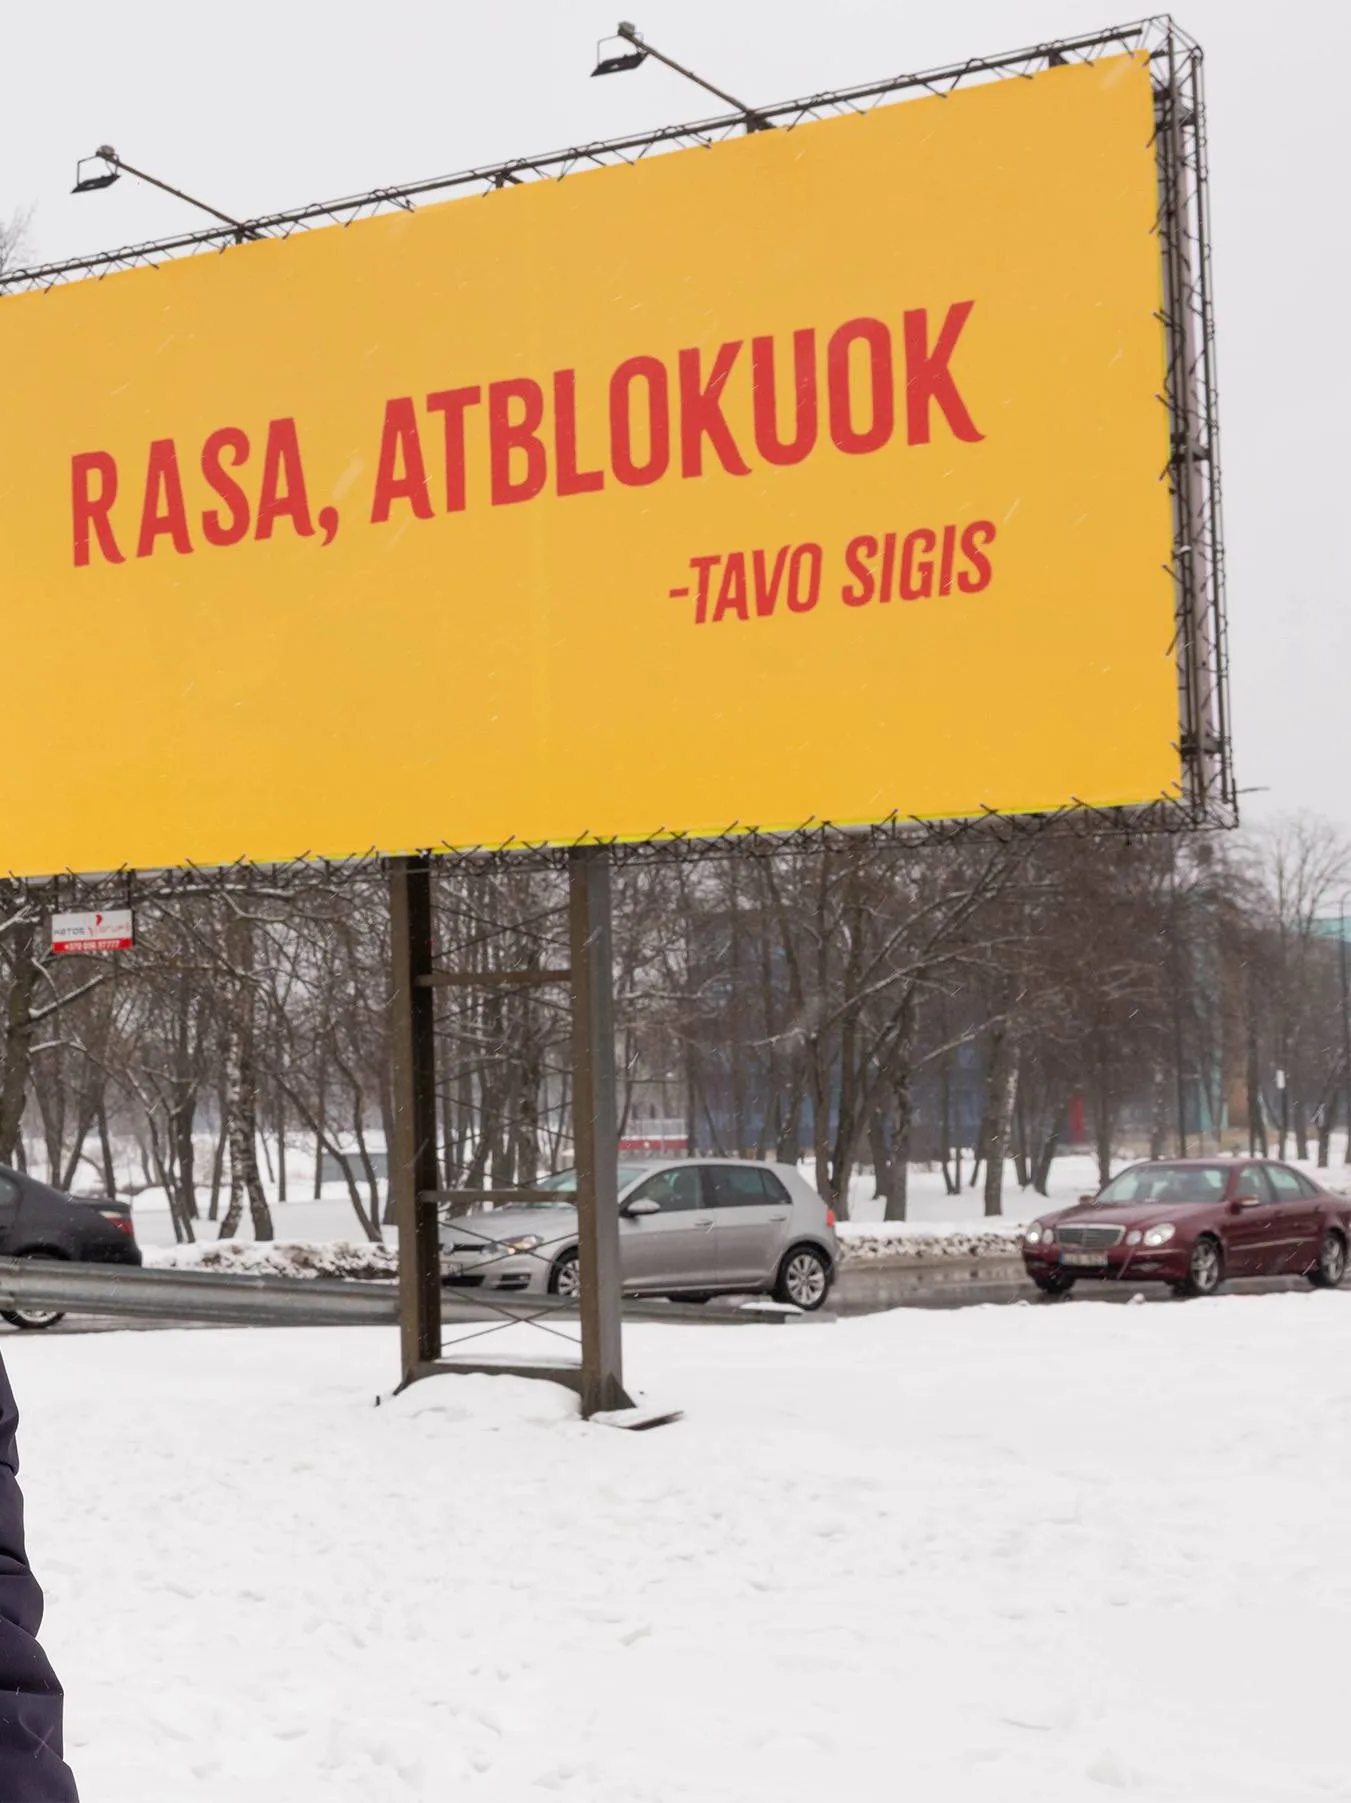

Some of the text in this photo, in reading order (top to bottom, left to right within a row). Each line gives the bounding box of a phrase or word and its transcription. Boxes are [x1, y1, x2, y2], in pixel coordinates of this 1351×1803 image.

[71, 300, 984, 568] RASA, ATBLOKUOK
[669, 520, 996, 625] -TAVO SIGIS
